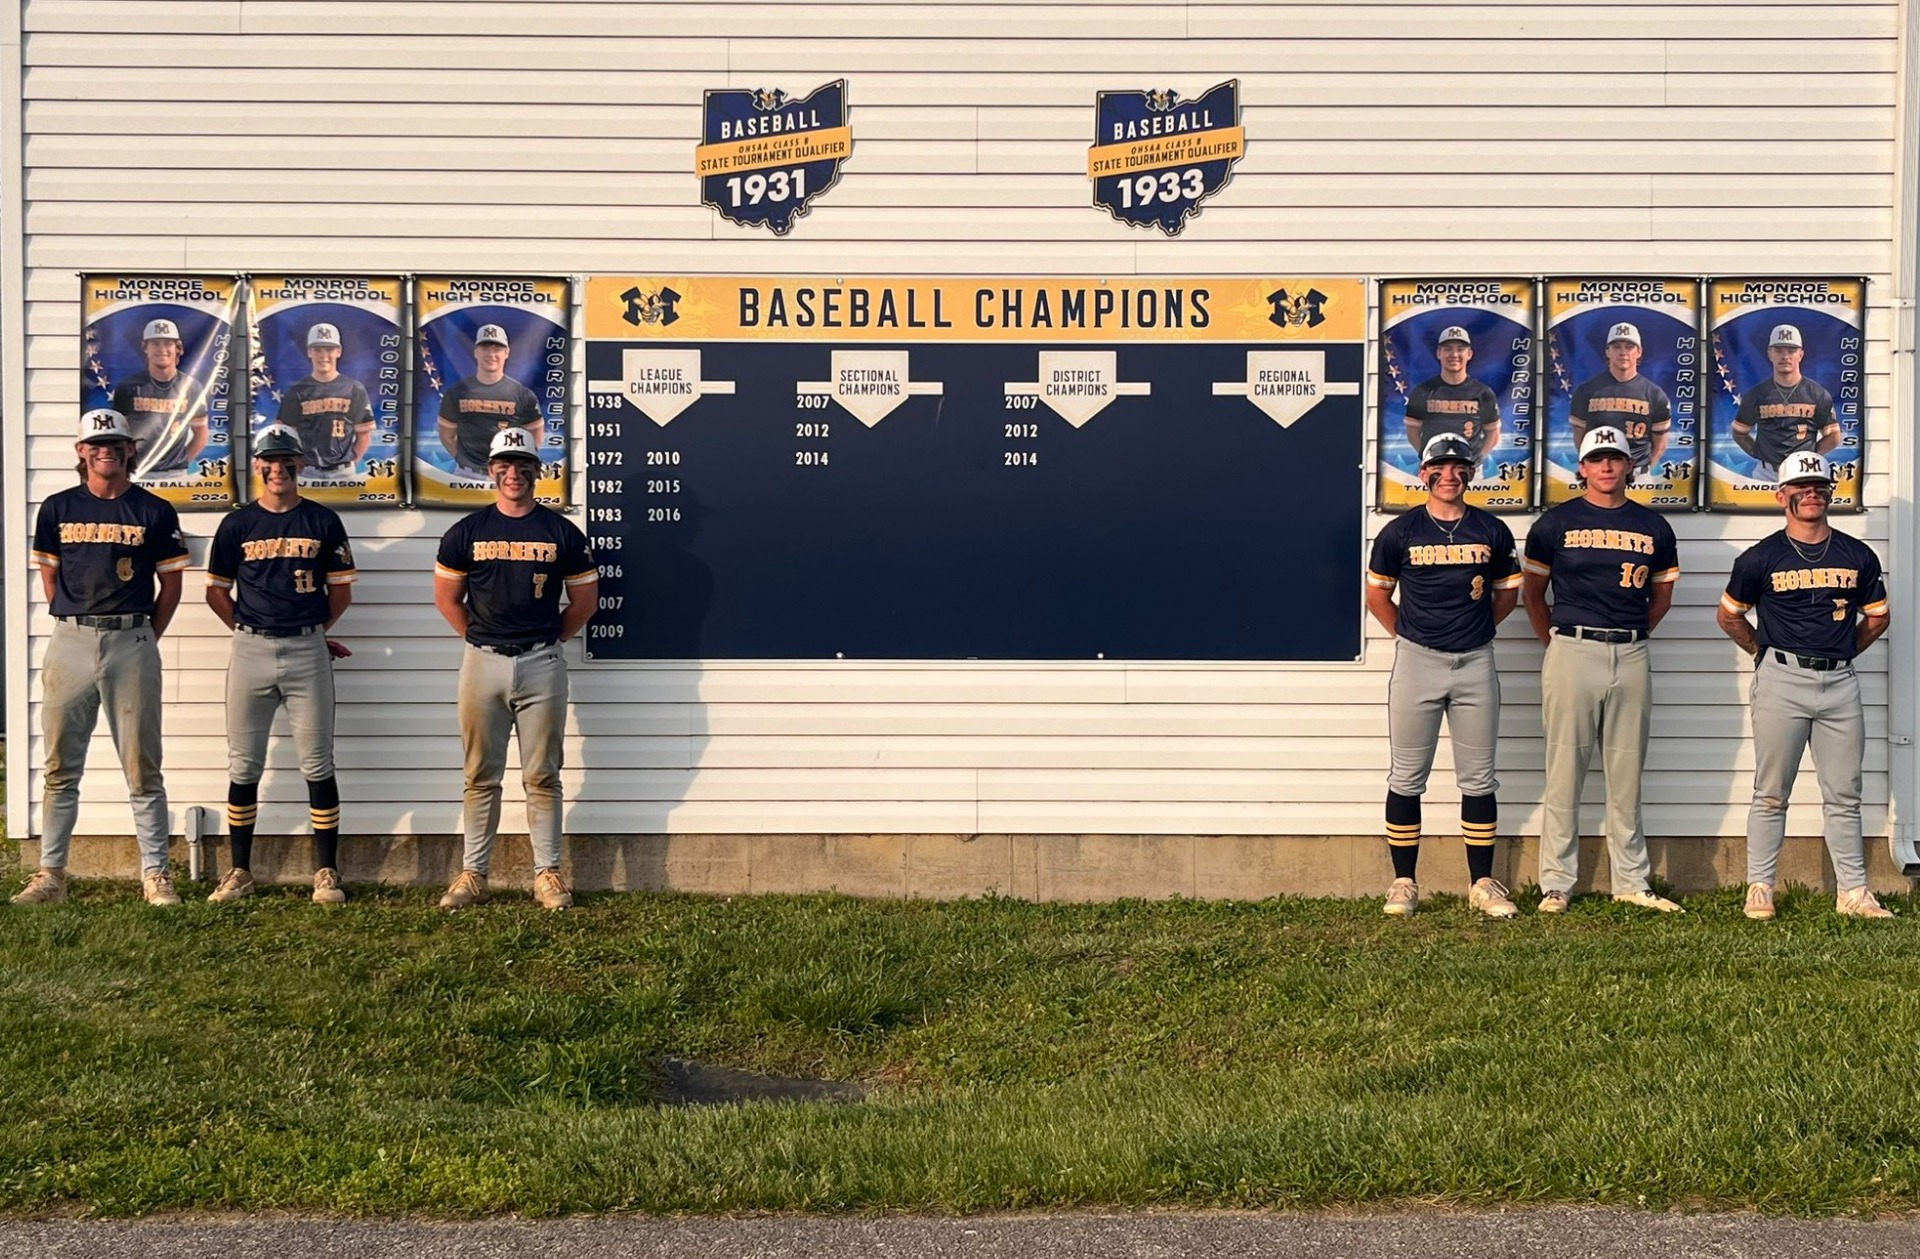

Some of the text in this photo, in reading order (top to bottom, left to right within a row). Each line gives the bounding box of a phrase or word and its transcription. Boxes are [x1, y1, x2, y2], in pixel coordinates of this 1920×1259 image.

[721, 109, 821, 139] BASEBALL
[1114, 110, 1213, 140] BASEBALL
[738, 144, 769, 154] OHSAA
[773, 139, 800, 149] CLASS
[1131, 144, 1161, 155] OHSAA
[1166, 139, 1193, 150] CLASS
[701, 141, 845, 171] STATE TOURNAMENT QUALIFIER
[1093, 142, 1238, 172] STATE TOURNAMENT QUALIFIER
[726, 168, 805, 207] 1931
[1117, 168, 1205, 208] 1933
[119, 279, 203, 291] MONROE
[284, 279, 369, 290] MONROE
[450, 281, 534, 292] MONROE
[1416, 283, 1500, 294] MONROE
[1580, 282, 1664, 293] MONROE
[1744, 283, 1828, 293] MONROE
[95, 290, 228, 301] HIGH SCHOOL
[260, 289, 392, 301] HIGH SCHOOL
[427, 291, 557, 303] HIGH SCHOOL
[1392, 294, 1523, 304] HIGH SCHOOL
[1557, 292, 1687, 303] HIGH SCHOOL
[1720, 293, 1852, 304] HIGH SCHOOL
[738, 287, 953, 328] BASEBALL
[975, 288, 1211, 329] CHAMPIONS
[640, 368, 683, 381] LEAGUE
[840, 369, 899, 383] SECTIONAL
[1053, 370, 1102, 383] DISTRICT
[1259, 370, 1312, 383] REGIONAL
[211, 334, 231, 444] HORNETS
[380, 335, 400, 443] HORNETS
[546, 336, 566, 446] HORNETS
[630, 381, 693, 395] CHAMPIONS
[839, 383, 900, 397] CHAMPIONS
[1046, 383, 1108, 396] CHAMPIONS
[1254, 383, 1316, 396] CHAMPIONS
[1511, 337, 1531, 448] HORNETS
[1676, 336, 1696, 446] HORNETS
[1840, 337, 1860, 447] HORNETS
[589, 395, 622, 409] 1938
[796, 395, 830, 409] 2007
[1004, 396, 1038, 409] 2007
[589, 423, 621, 437] 1951
[796, 424, 829, 437] 2012
[1004, 425, 1038, 438] 2012
[590, 452, 623, 466] 1972
[646, 452, 680, 466] 2010
[795, 452, 829, 466] 2014
[1004, 452, 1038, 466] 2014
[590, 480, 623, 494] 1982
[647, 480, 681, 493] 2015
[589, 508, 622, 522] 1983
[648, 508, 681, 522] 2016
[59, 522, 147, 547] HORNETS
[1564, 528, 1654, 555] HORNETS
[241, 538, 322, 561] HORNETS
[590, 537, 622, 550] 1985
[473, 541, 558, 562] HORNETS
[1408, 544, 1491, 566] HORNETS
[116, 557, 135, 582] 6
[599, 565, 623, 578] 986
[1619, 562, 1650, 589] 10
[533, 572, 548, 599] 7
[1771, 568, 1859, 592] HORNETS
[599, 597, 624, 610] 007
[591, 625, 624, 638] 2009
